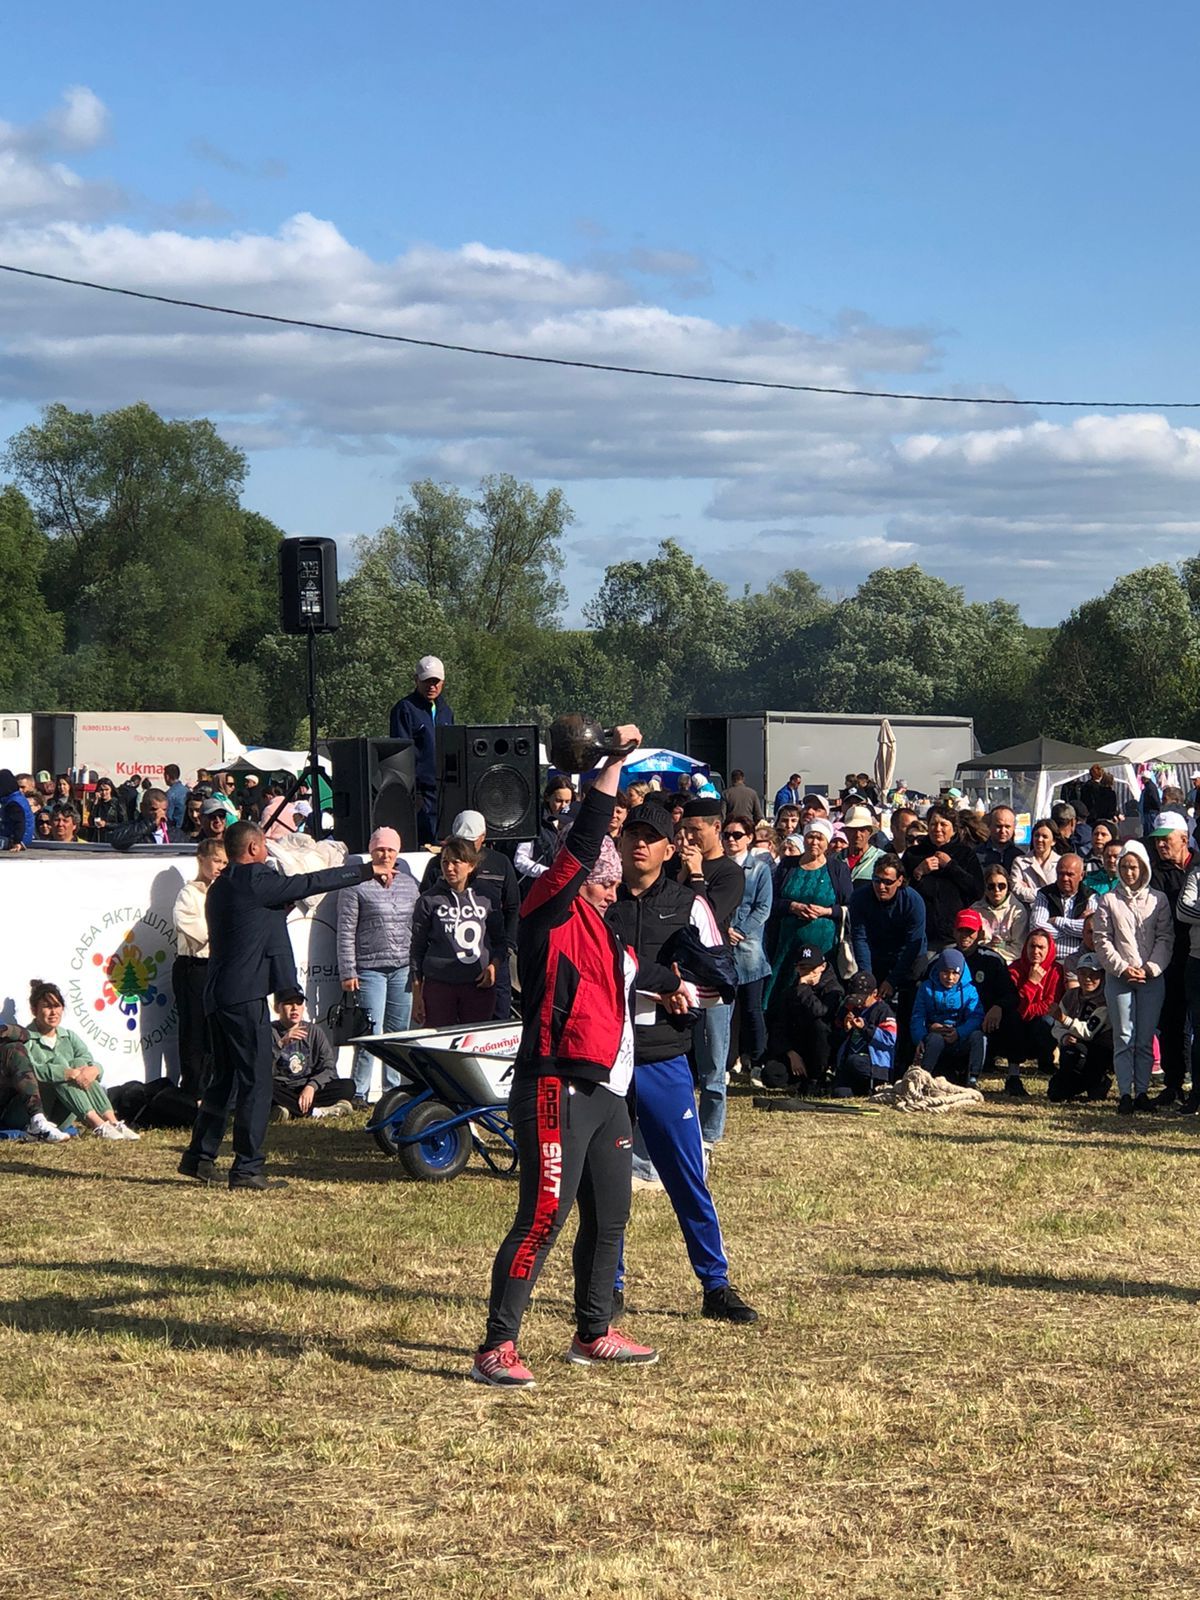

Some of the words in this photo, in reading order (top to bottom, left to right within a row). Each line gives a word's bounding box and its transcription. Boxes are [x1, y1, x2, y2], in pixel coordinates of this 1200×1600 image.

[116, 762, 165, 776] Kukma
[70, 925, 102, 970] САБА
[456, 920, 482, 964] 9
[69, 979, 119, 1052] ЗЕМЛЯКИ
[542, 1141, 562, 1199] SWT
